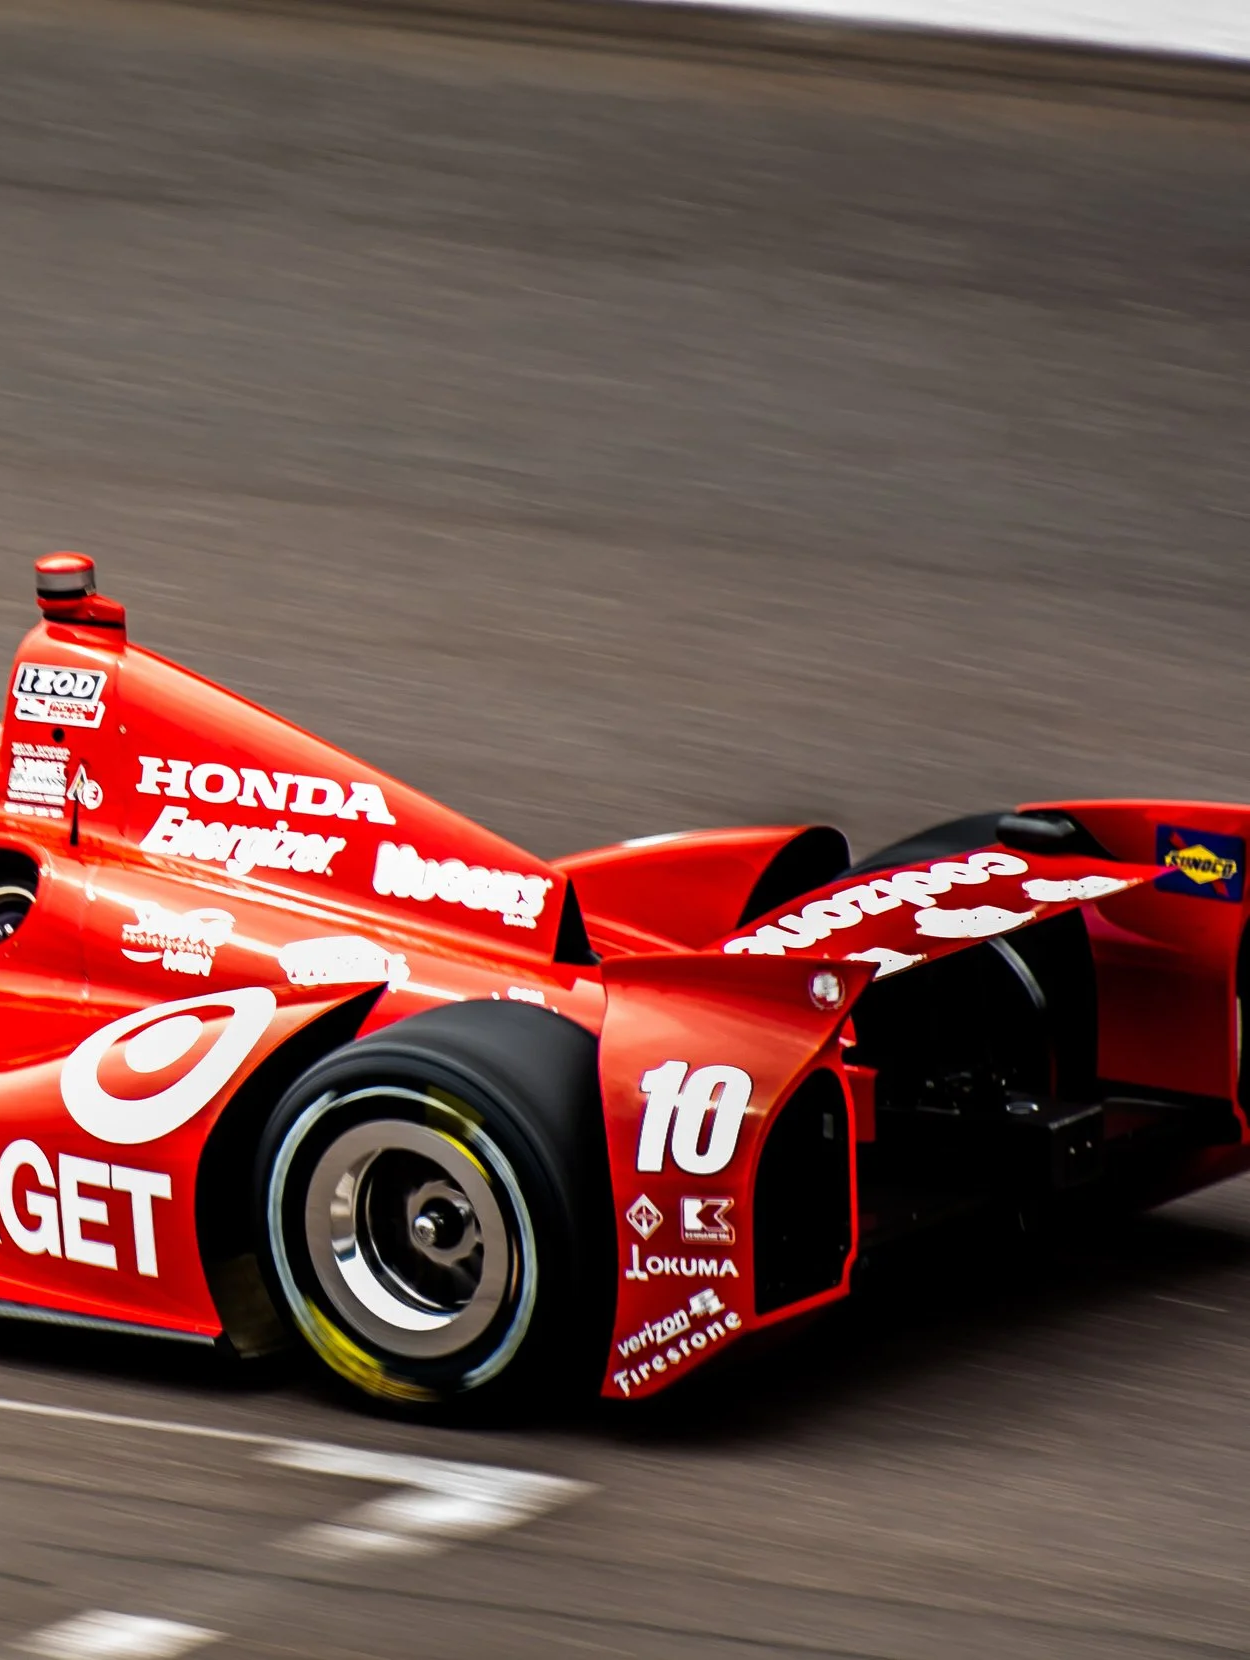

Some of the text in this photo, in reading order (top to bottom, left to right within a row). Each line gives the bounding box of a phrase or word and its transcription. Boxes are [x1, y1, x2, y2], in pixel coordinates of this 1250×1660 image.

[136, 755, 397, 826] HONDA
[139, 804, 349, 877] Energizer
[1164, 850, 1237, 880] SUNOCO
[636, 1059, 754, 1176] 10
[613, 1311, 742, 1398] Firestone
[617, 1308, 692, 1359] verizon
